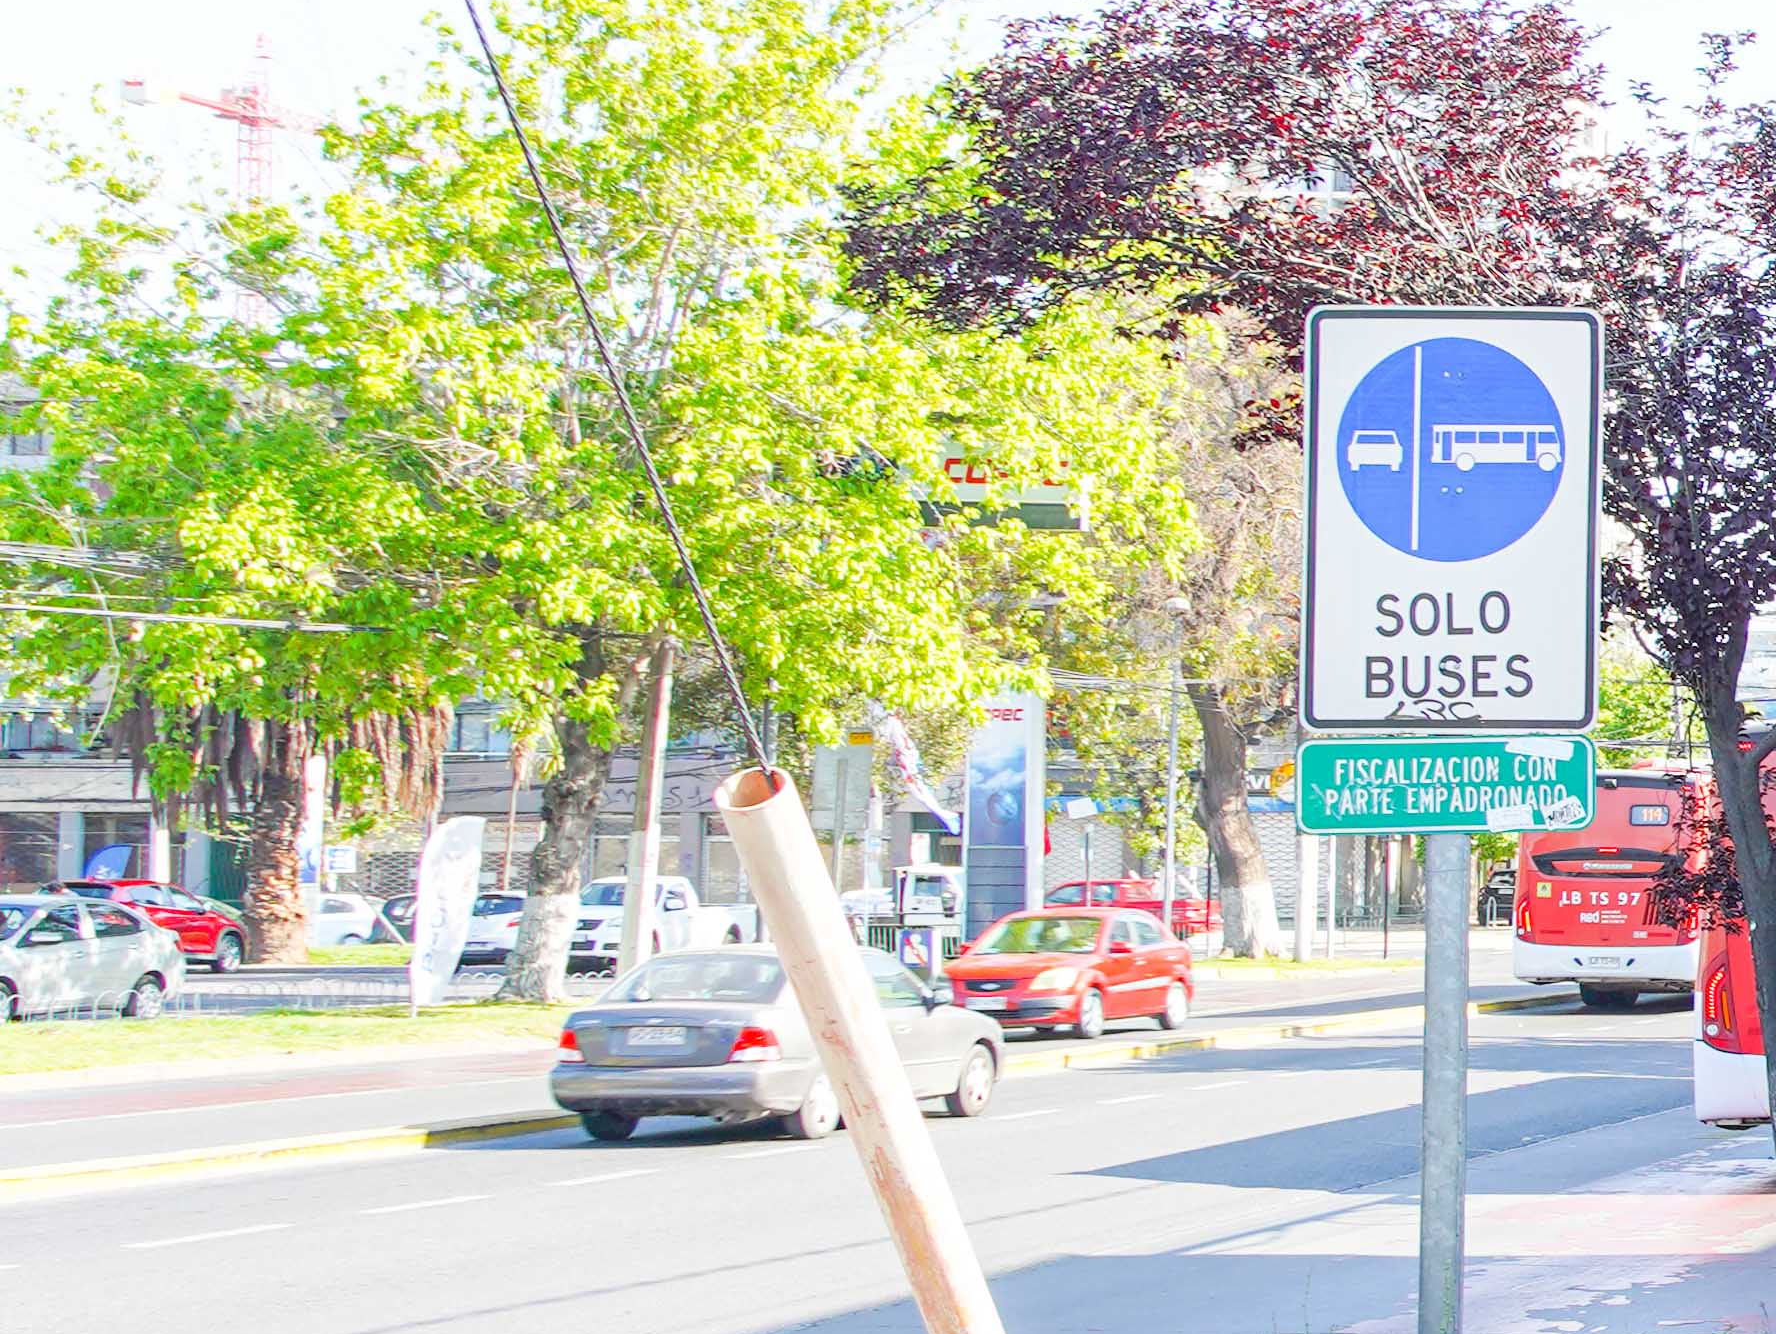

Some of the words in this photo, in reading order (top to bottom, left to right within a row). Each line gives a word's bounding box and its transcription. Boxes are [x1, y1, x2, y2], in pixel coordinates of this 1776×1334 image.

[1375, 590, 1511, 638] SOLO
[1365, 653, 1534, 699] BUSES
[1334, 755, 1500, 786] FISCALIZACION
[1513, 754, 1558, 781] CON
[1325, 788, 1394, 816] PARTE
[1406, 783, 1568, 815] EMPADRONADO
[1561, 891, 1582, 905] LB
[1589, 891, 1609, 906] TS
[1617, 892, 1641, 906] 97
